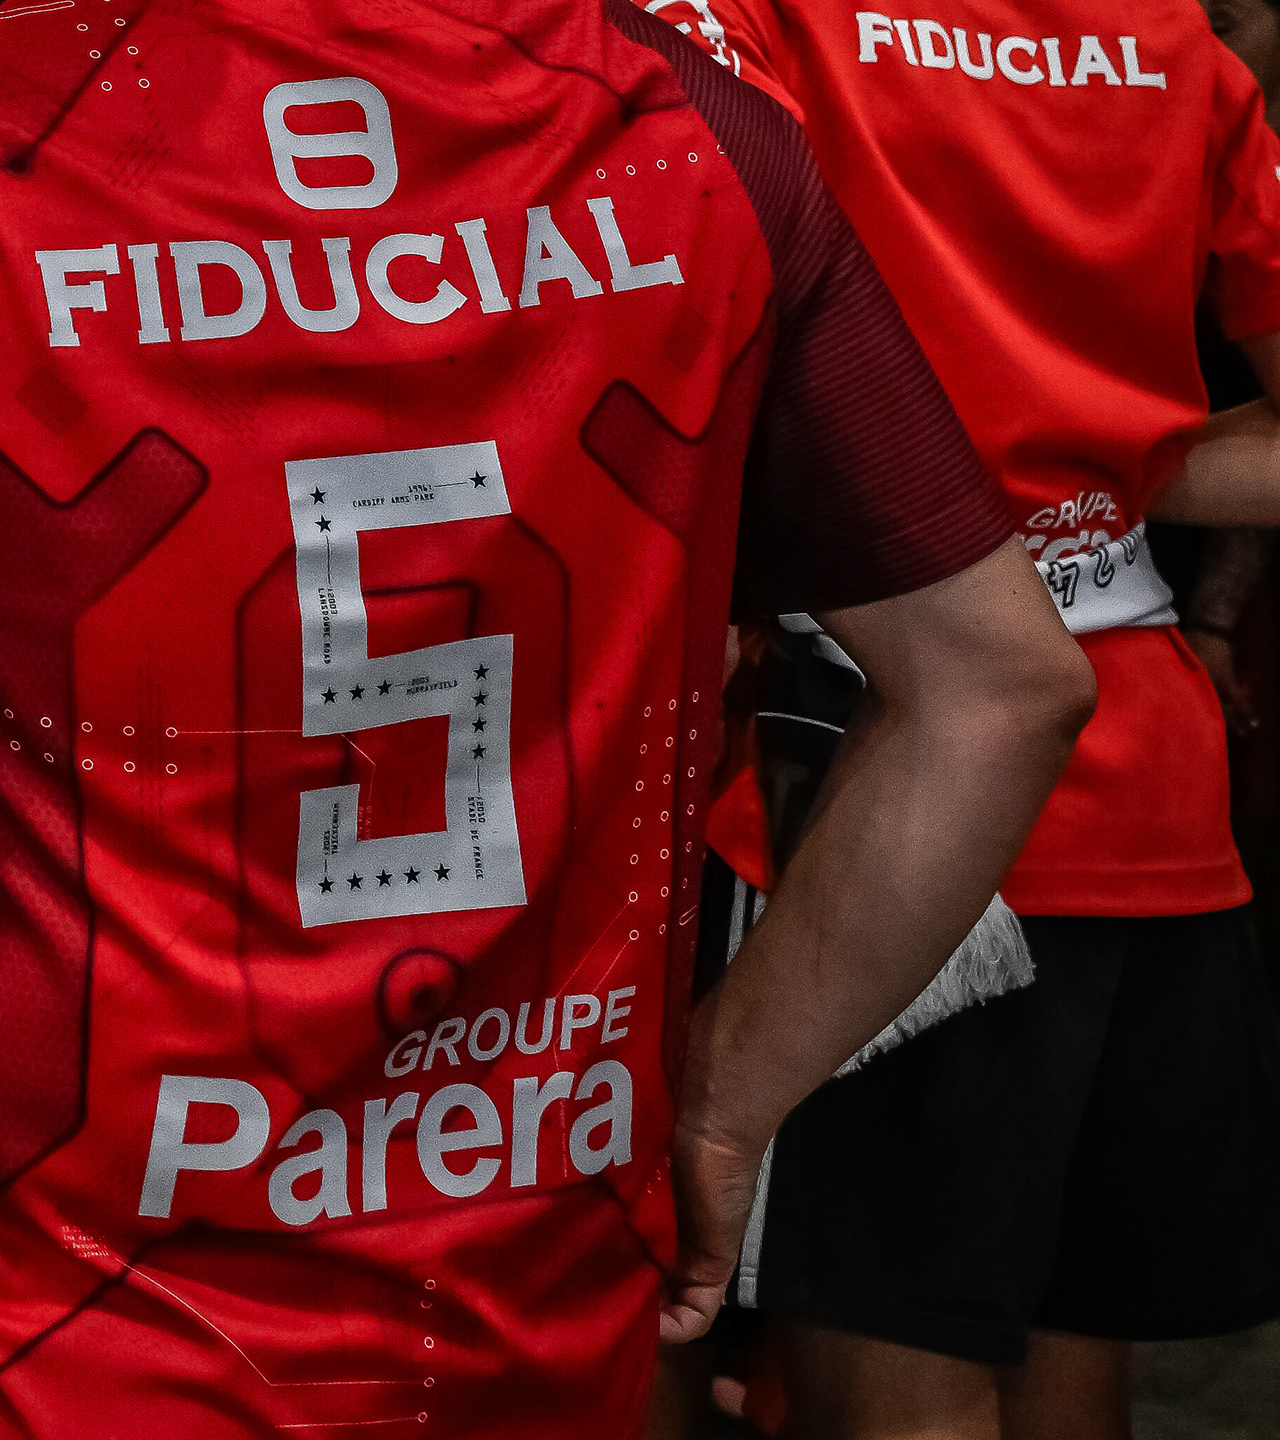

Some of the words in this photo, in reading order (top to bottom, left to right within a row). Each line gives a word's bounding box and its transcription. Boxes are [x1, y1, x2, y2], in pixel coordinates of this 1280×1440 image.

[853, 10, 1168, 92] FIDUCIAL
[36, 195, 684, 349] FIDUCIAL
[352, 497, 386, 508] CARDIFF
[390, 494, 410, 505] ARMS
[414, 492, 436, 503] PARK
[318, 587, 332, 638] LANSDOWNE
[322, 642, 331, 665] ROAD
[285, 440, 528, 928] 5
[406, 678, 459, 697] MURRAYFIELD
[331, 802, 340, 856] TWICKENHAM
[467, 796, 478, 825] STADE
[471, 829, 480, 842] DE
[473, 845, 485, 880] FRANCE
[385, 986, 637, 1079] GROUPE
[138, 1060, 634, 1228] Parera
